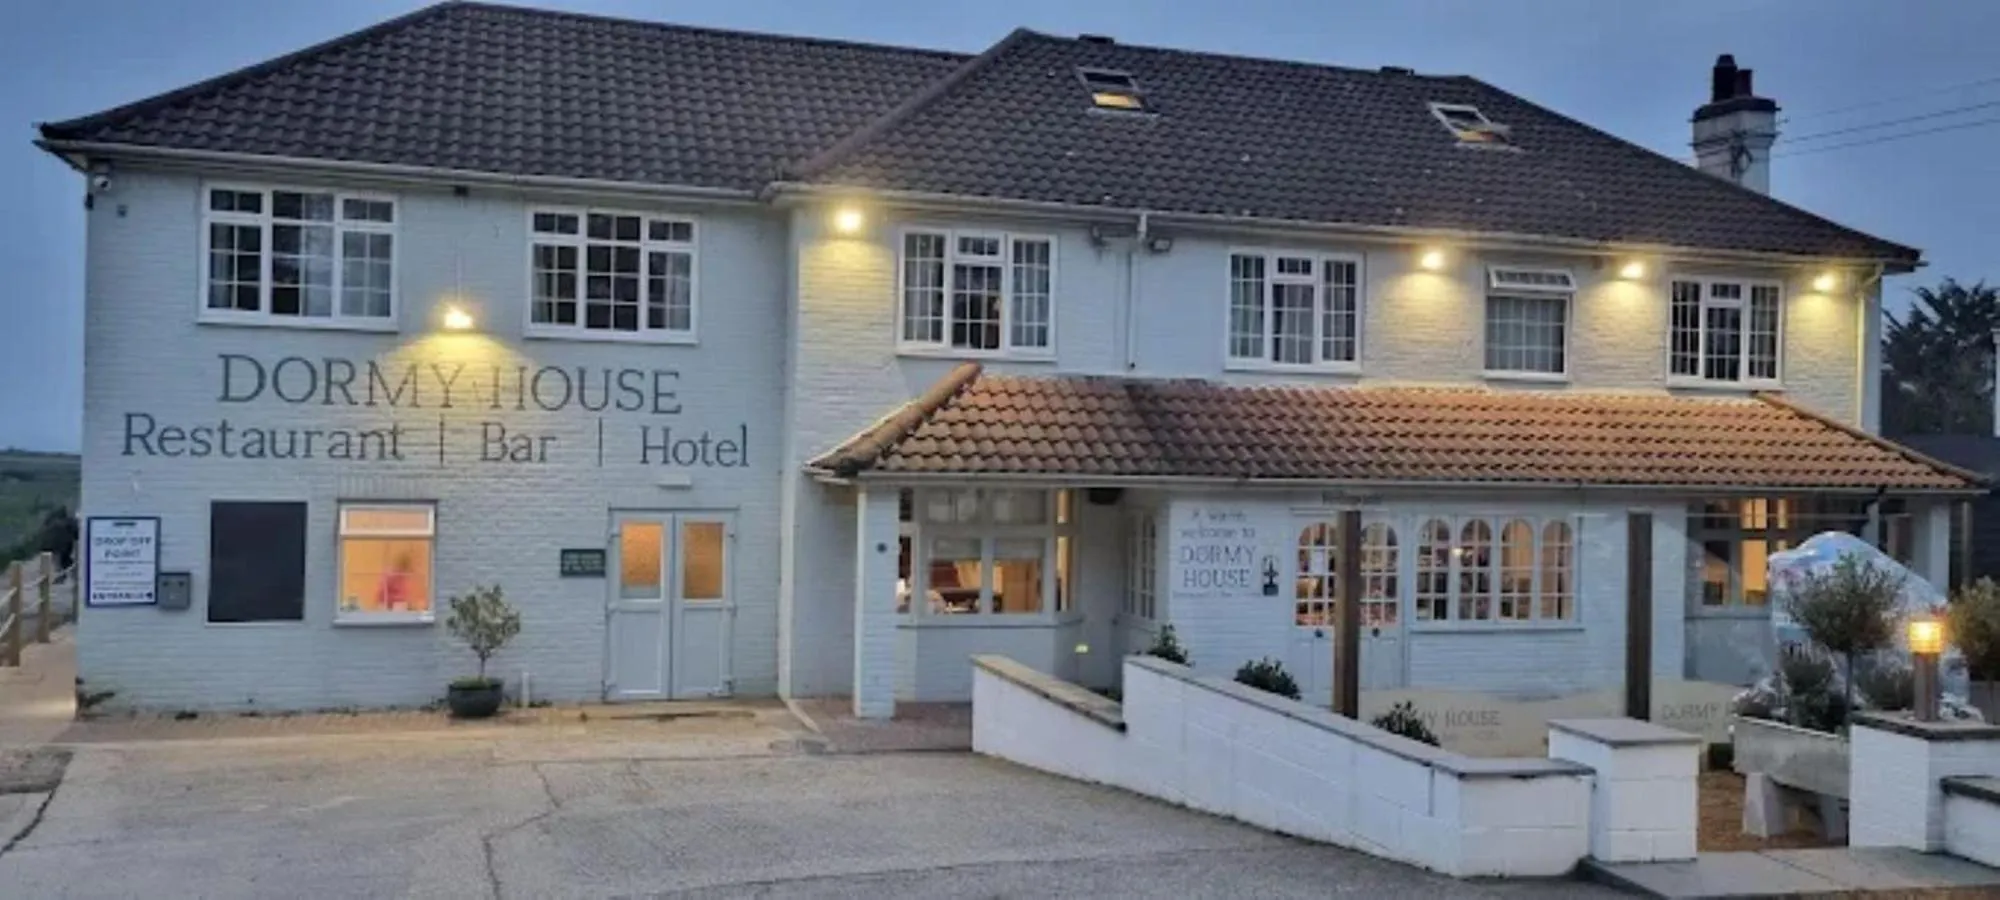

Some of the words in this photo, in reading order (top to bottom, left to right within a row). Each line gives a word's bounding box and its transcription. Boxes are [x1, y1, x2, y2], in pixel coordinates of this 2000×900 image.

[216, 353, 466, 408] DORMY
[488, 364, 683, 415] HOUSE
[121, 412, 405, 460] Restaurant
[480, 421, 557, 463] Bar
[640, 422, 750, 467] Hotel
[1179, 544, 1257, 565] DORMY
[1183, 568, 1251, 588] HOUSE
